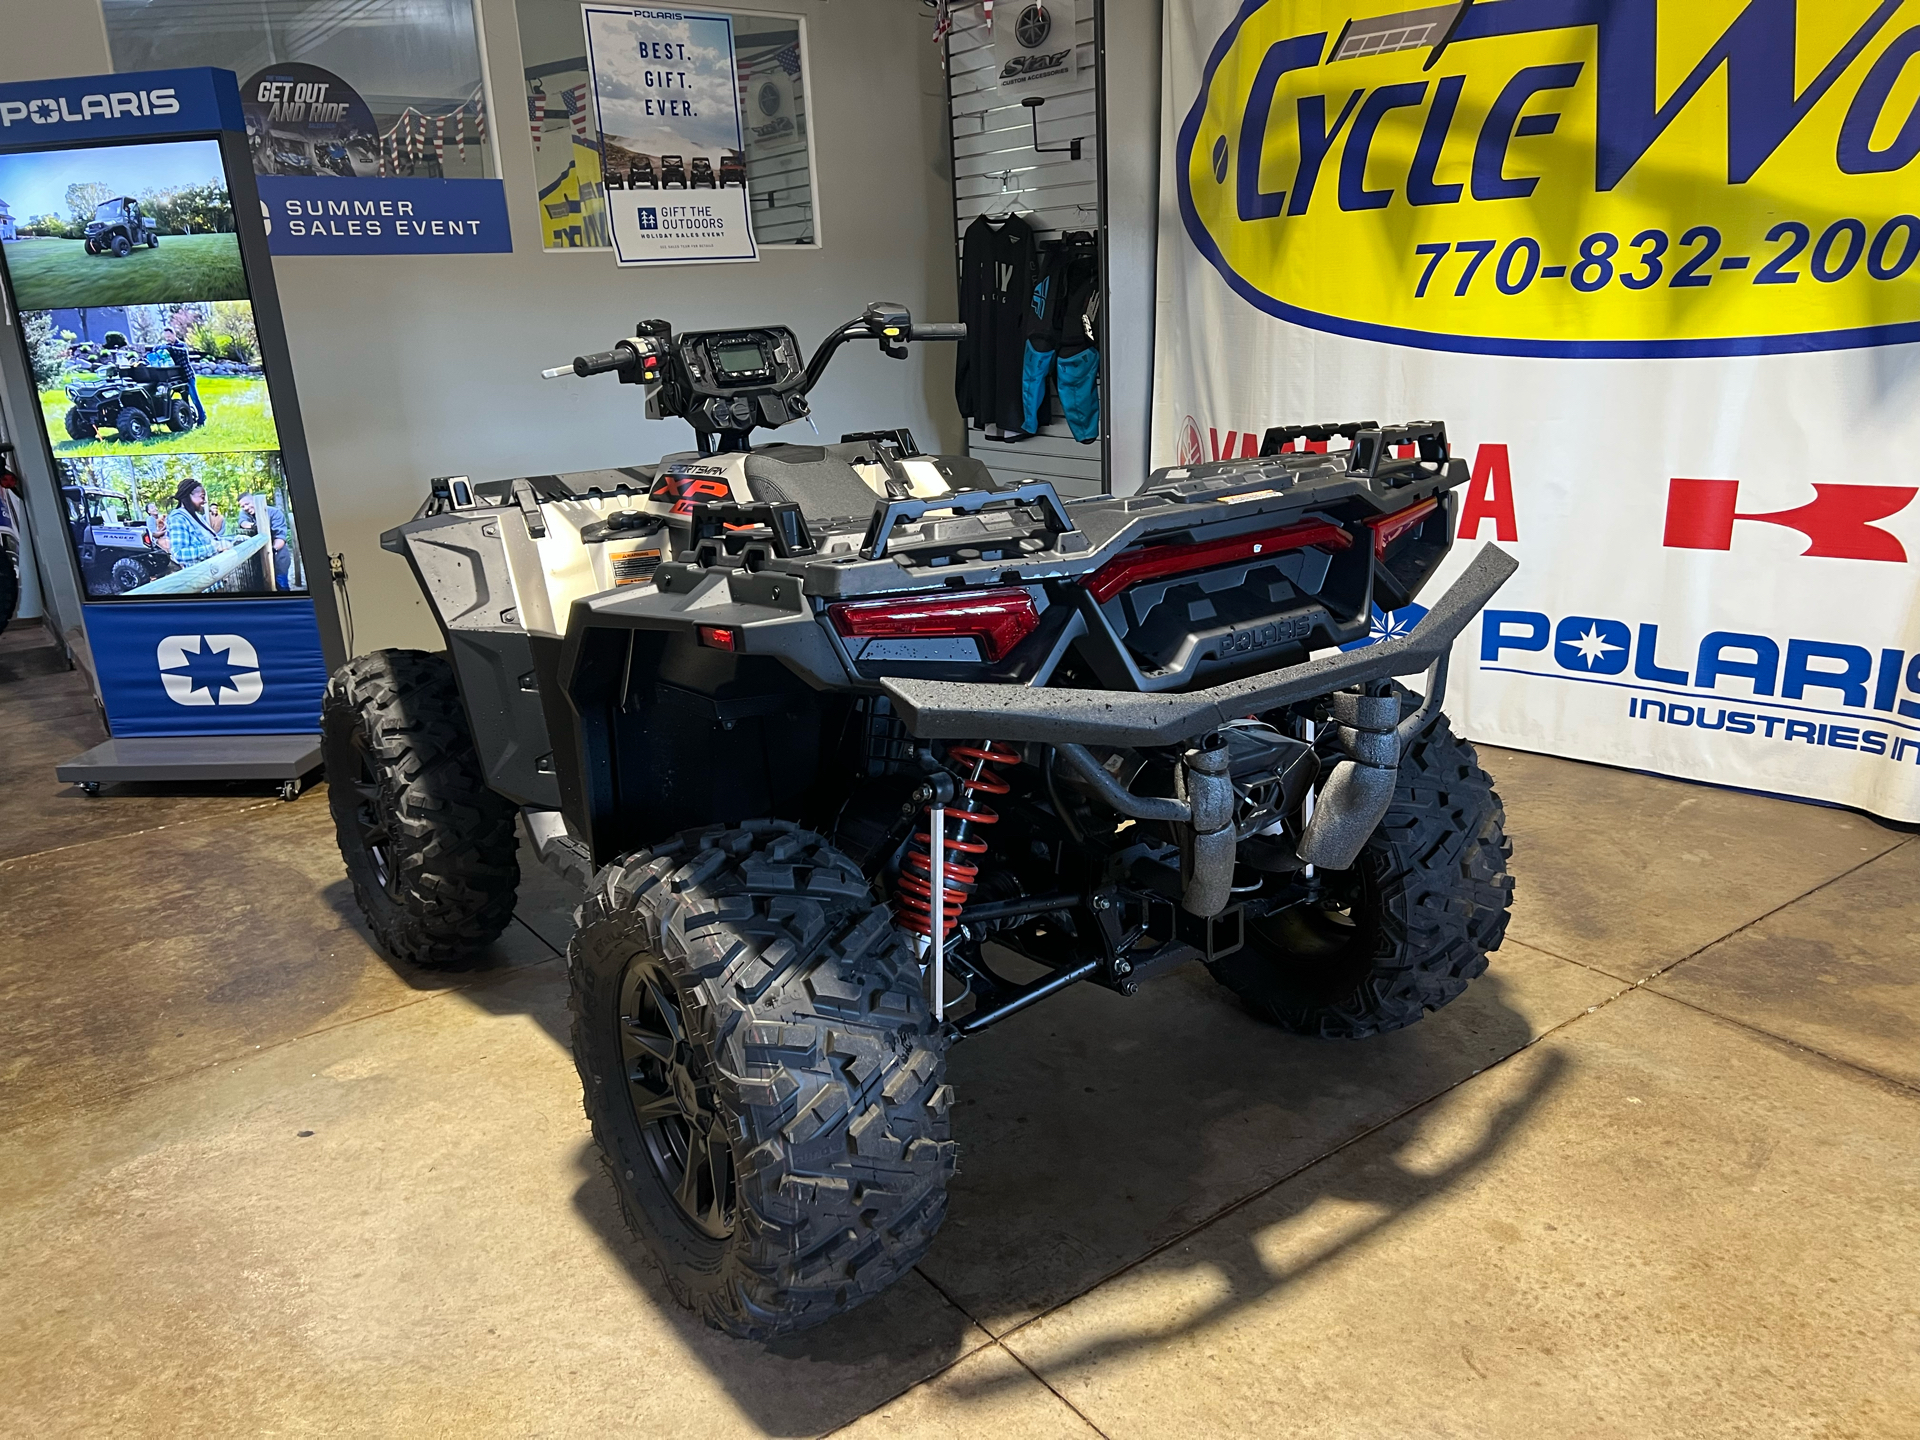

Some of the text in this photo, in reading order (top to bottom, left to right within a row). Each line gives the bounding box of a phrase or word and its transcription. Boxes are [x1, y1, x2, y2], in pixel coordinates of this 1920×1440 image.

[634, 10, 683, 21] POLARIS
[639, 41, 692, 61] BEST.
[999, 48, 1072, 79] Star
[644, 70, 692, 89] GIFT.
[1002, 67, 1069, 87] CUSTOM ACCESSORIES
[257, 81, 330, 103] GET OUT
[0, 88, 180, 127] POLARIS
[267, 102, 350, 122] AND RIDE
[644, 98, 698, 117] EVER.
[285, 200, 414, 216] SUMMER
[661, 206, 712, 217] GIFT THE
[289, 220, 481, 236] SALES EVENT
[662, 218, 724, 230] OUTDOORS
[667, 464, 728, 476] SPORTSMAN
[653, 476, 729, 498] XP
[1220, 616, 1310, 655] POLARIS
[1480, 608, 1920, 720] POLARI
[1629, 697, 1888, 756] INDUSTRIES
